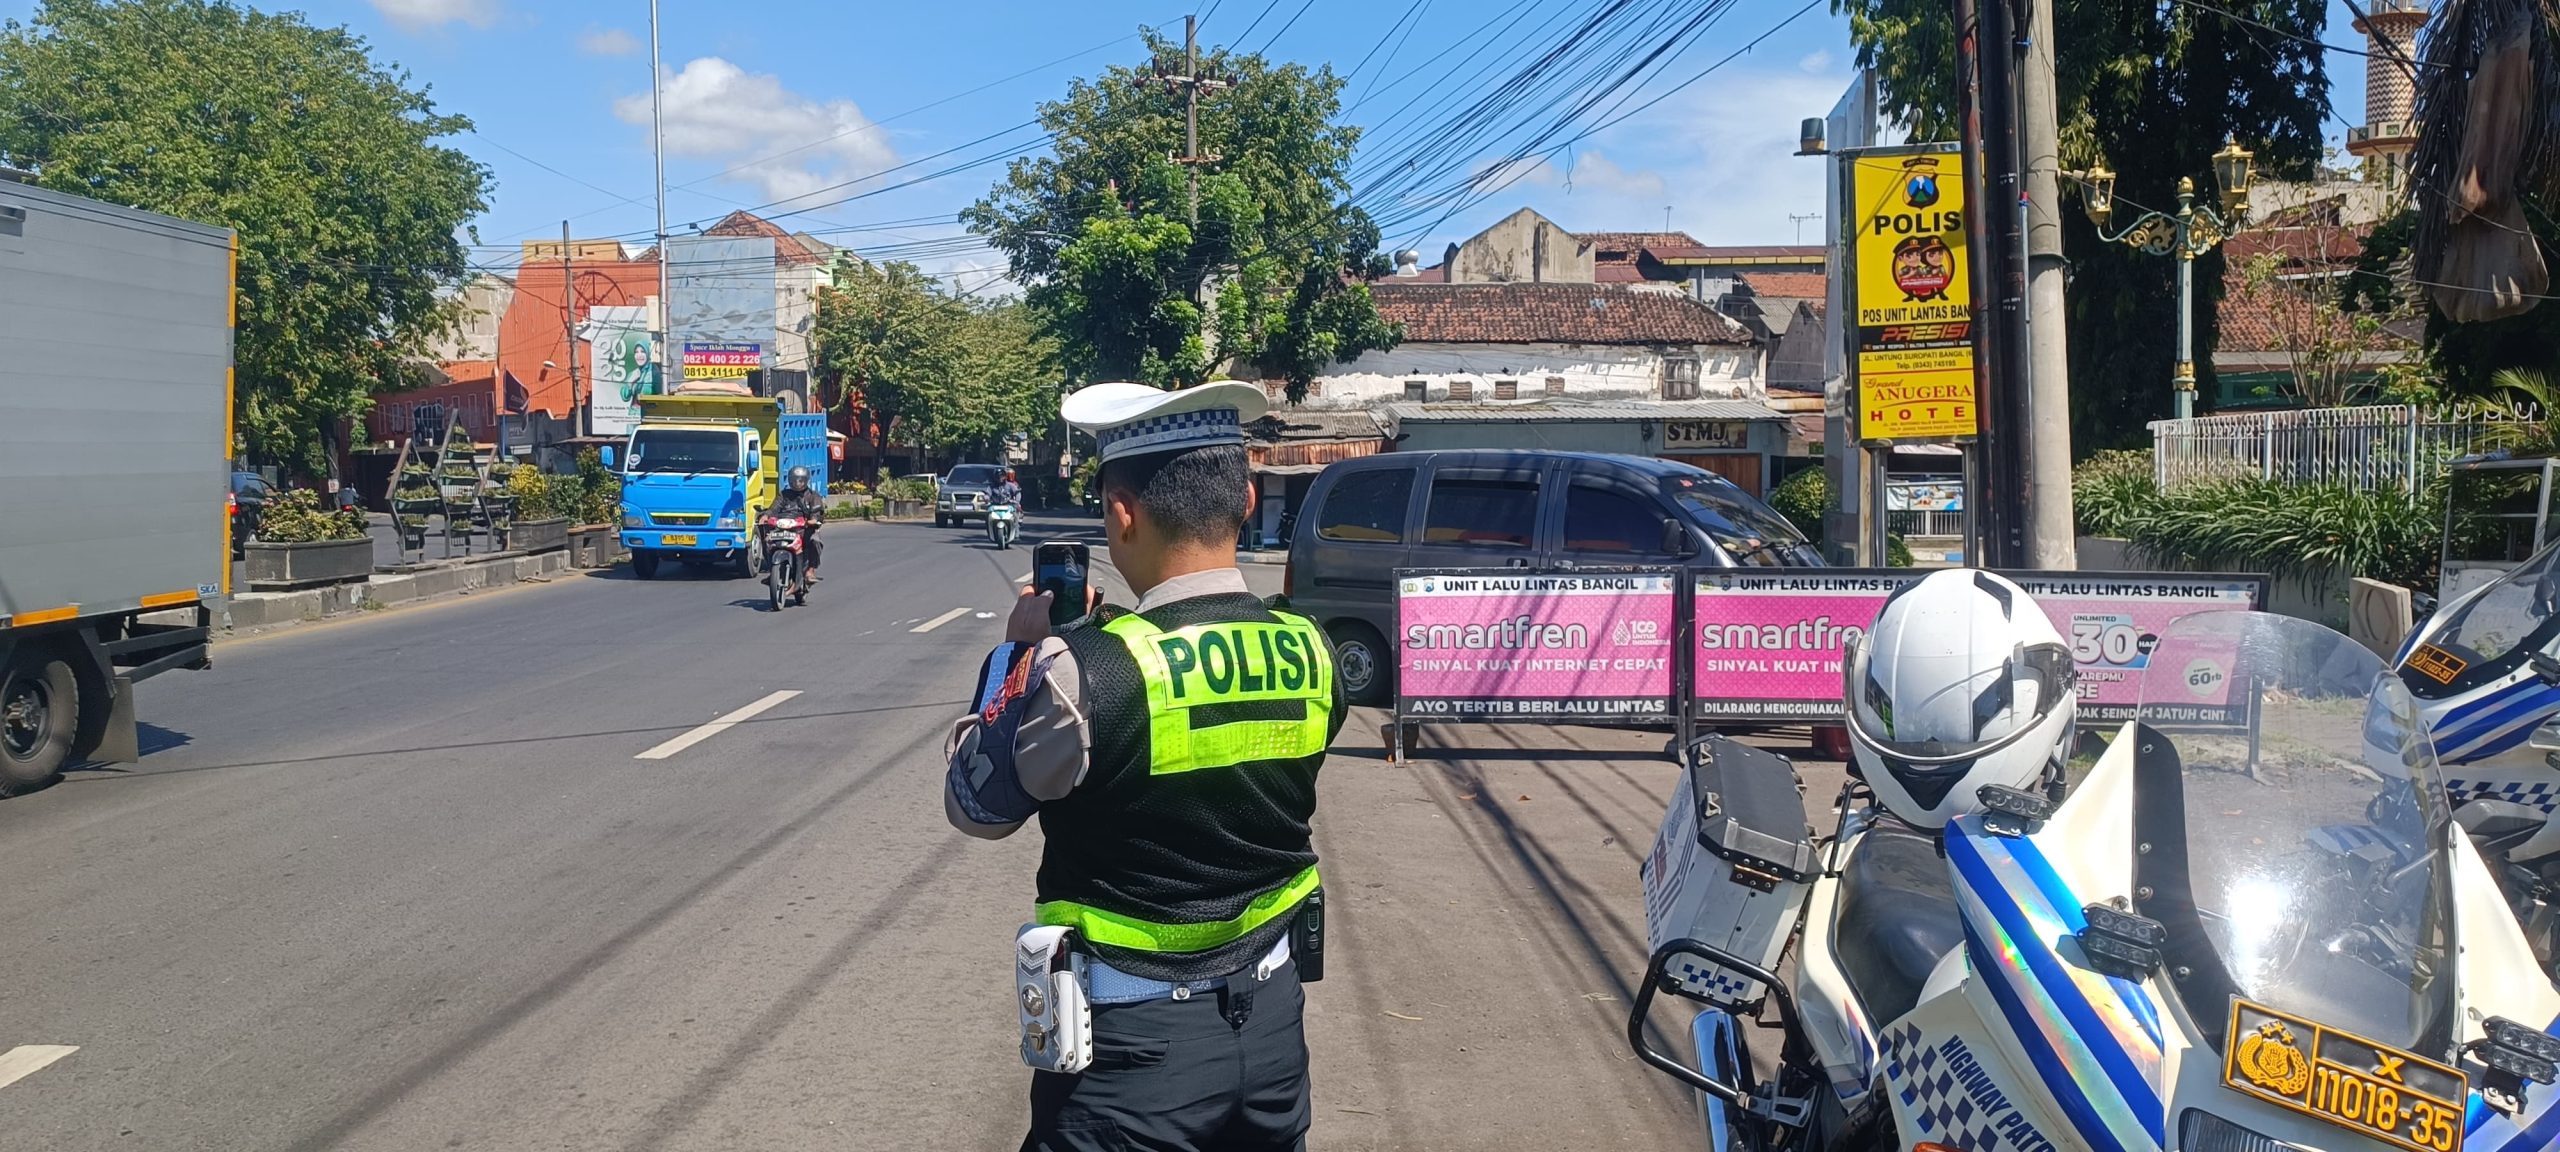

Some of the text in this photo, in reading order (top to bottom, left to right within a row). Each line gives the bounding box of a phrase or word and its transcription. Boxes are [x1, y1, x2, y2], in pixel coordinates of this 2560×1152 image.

[1874, 211, 1964, 235] POLIS
[1863, 309, 1882, 322] POS
[1885, 308, 1907, 321] UNIT
[1911, 306, 1947, 320] LANTAS
[1881, 323, 1970, 342] PRESISI
[684, 354, 760, 364] 0821 400 22 226
[1874, 353, 1903, 361] UNTUNG
[1904, 352, 1937, 360] SUROPATI
[1939, 350, 1965, 358] BANGIL
[684, 367, 708, 377] 0813
[710, 367, 733, 377] 4111
[1864, 379, 1904, 388] Grand
[1667, 422, 1726, 441] STMJ
[1443, 578, 1638, 592] UNIT LALU LINTAS BANGIL
[1740, 579, 1776, 591] UNIT
[1781, 579, 1820, 591] LALU
[1824, 579, 1879, 591] LINTAS
[2050, 583, 2091, 595] LALU
[2096, 584, 2153, 597] LINTAS
[2157, 585, 2219, 598] BANGIL
[1407, 615, 1588, 650] smartfren
[1630, 620, 1658, 634] 100
[2072, 623, 2138, 665] 30
[1158, 629, 1318, 699] POLISI
[1413, 659, 1666, 672] SINYAL KUAT INTERNET CEPAT
[1707, 660, 1769, 672] SINYAL
[1773, 660, 1819, 672] KUAT
[1411, 700, 1666, 713] AYO TERTIB BERLALU LINTAS
[1704, 702, 1761, 714] DILARANG
[2156, 707, 2197, 720] JATUH
[2374, 1049, 2405, 1083] X
[1939, 1034, 2013, 1119] HIGHWAY
[2316, 1066, 2456, 1152] 11018-35
